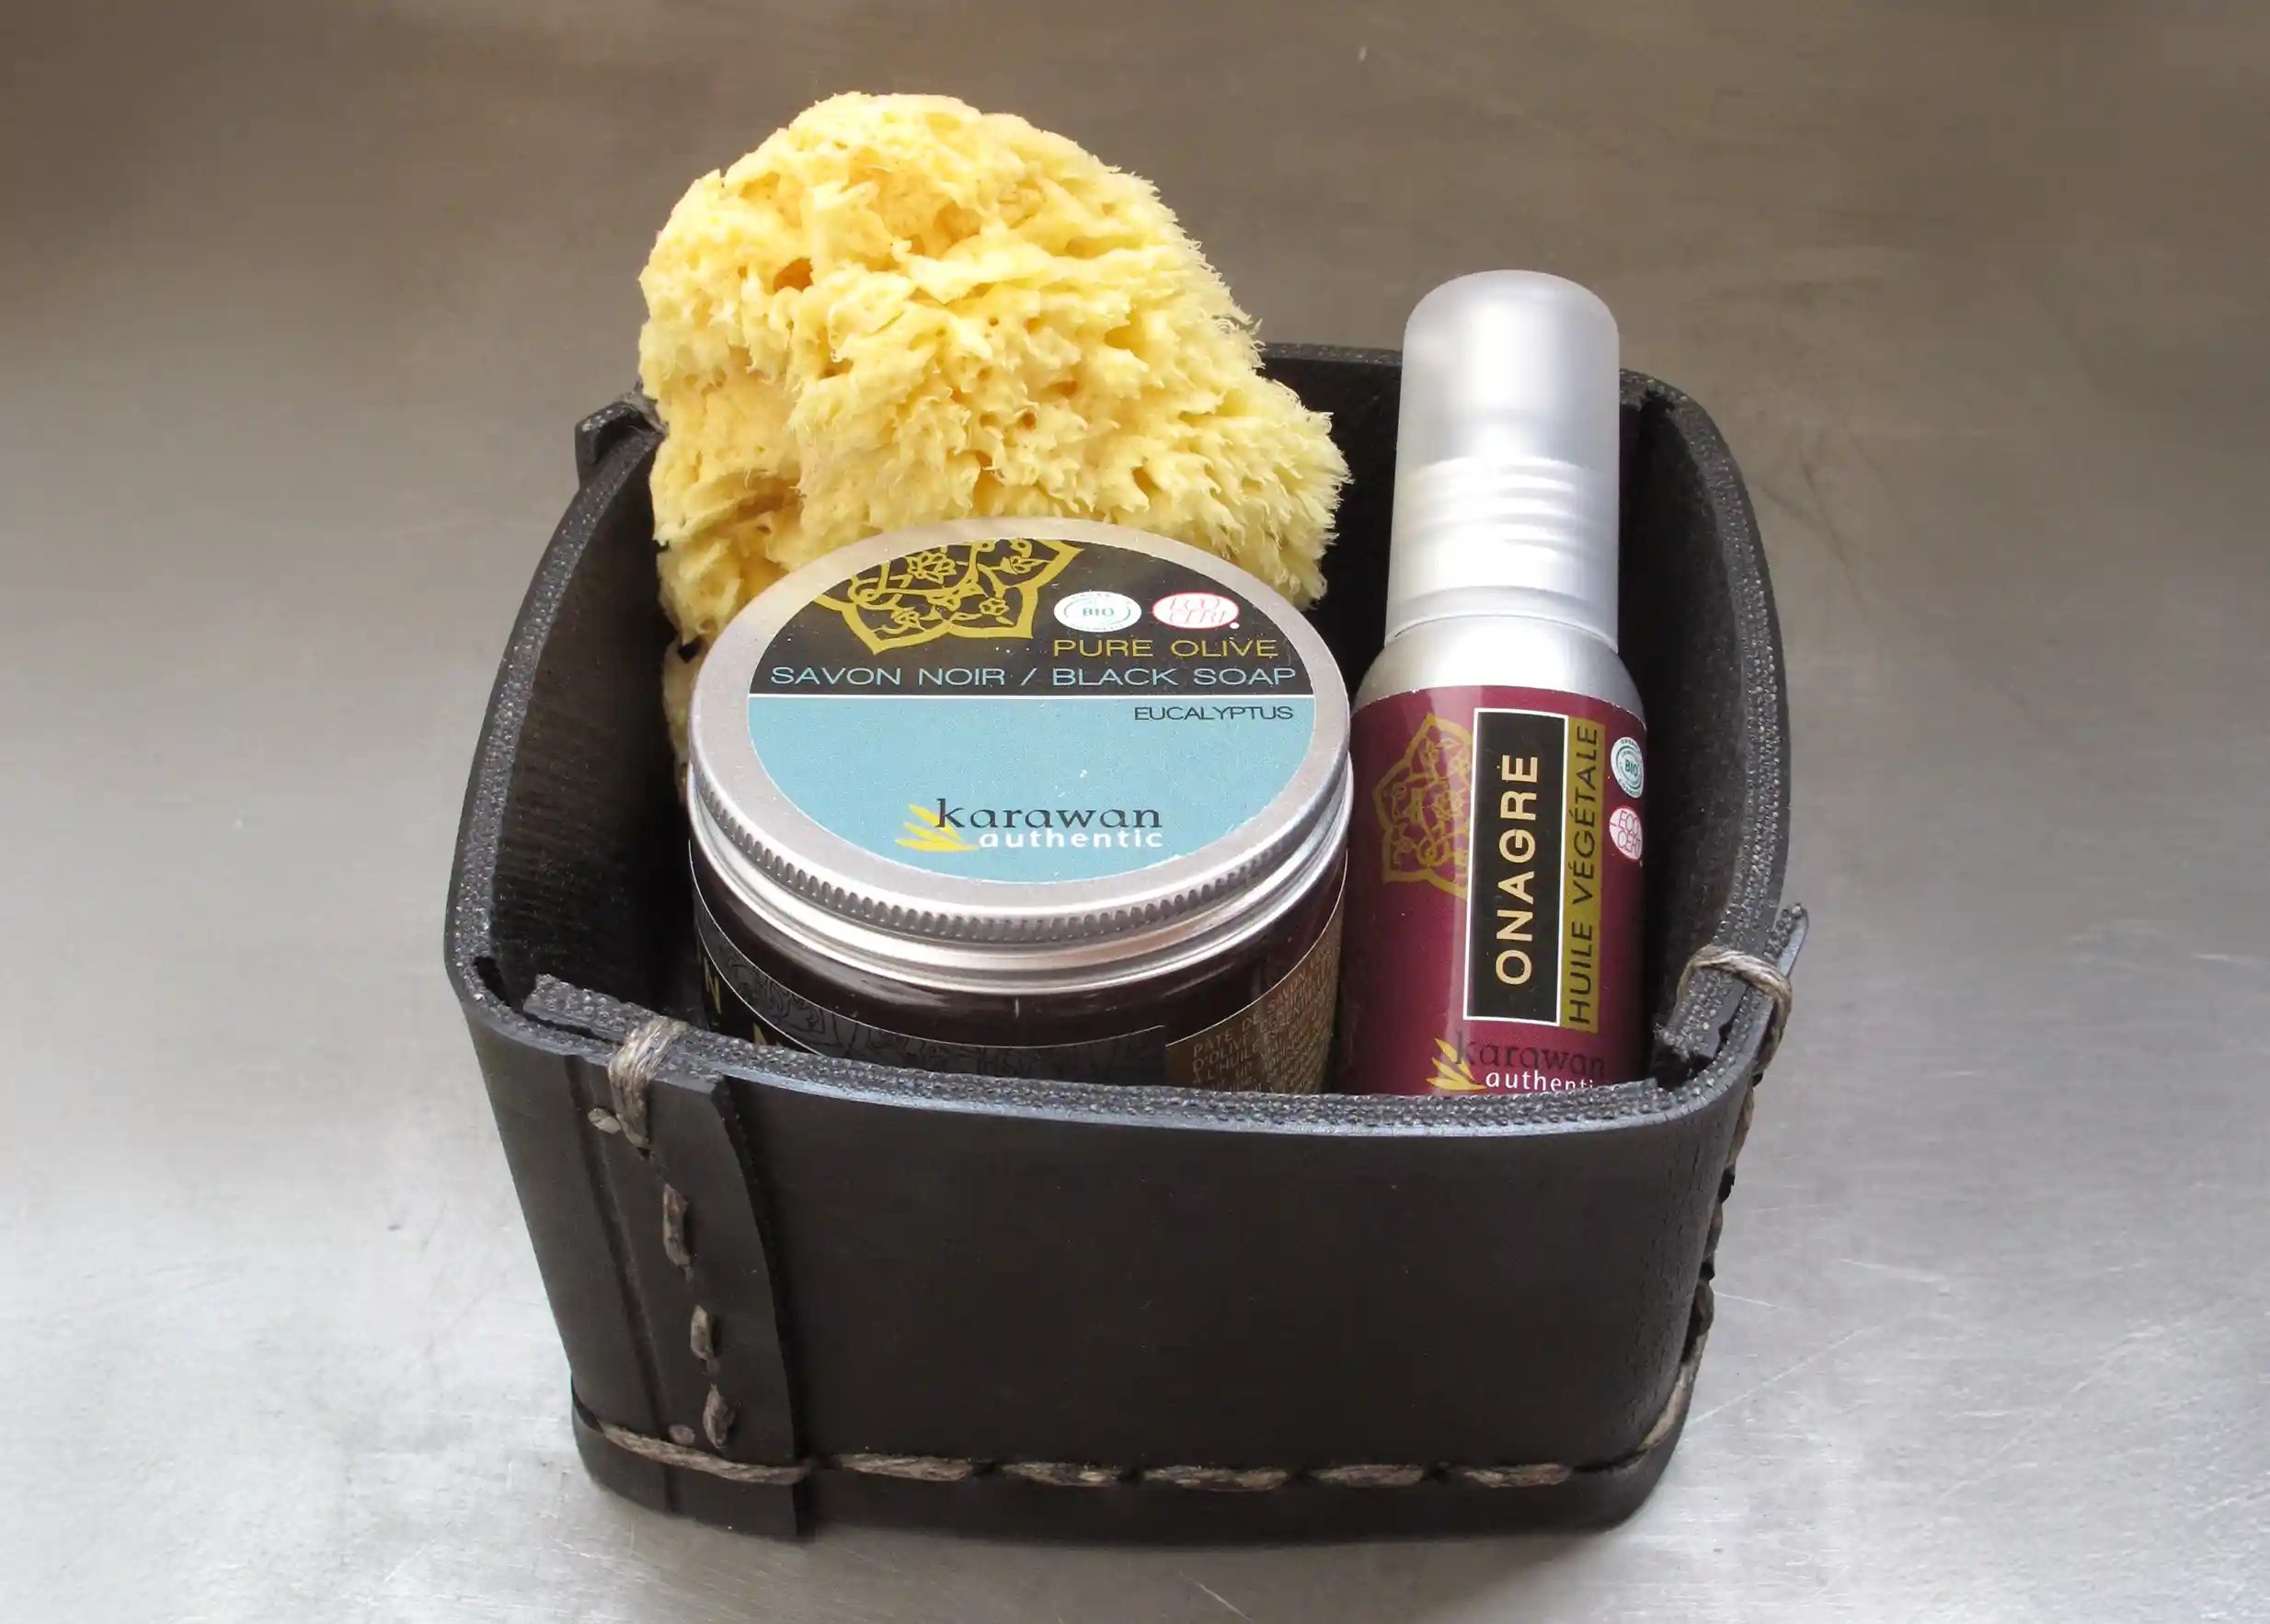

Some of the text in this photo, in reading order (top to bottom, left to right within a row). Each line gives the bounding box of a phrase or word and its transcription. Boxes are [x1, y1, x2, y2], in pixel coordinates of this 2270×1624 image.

[1082, 606, 1116, 618] BIO
[1053, 639, 1279, 658] PURE OLIVE
[770, 666, 1297, 687] SAVON NOIR / BLACK SOAP
[1133, 705, 1295, 721] EUCALYPTUS
[1623, 758, 1639, 778] BIO
[934, 797, 1164, 829] karawan
[978, 828, 1164, 849] authentic
[1496, 754, 1538, 986] ONAGRE
[1568, 726, 1598, 1025] HUILE VÉGÉTALE
[1454, 1030, 1606, 1081] karawan
[1485, 1069, 1595, 1092] authenti
